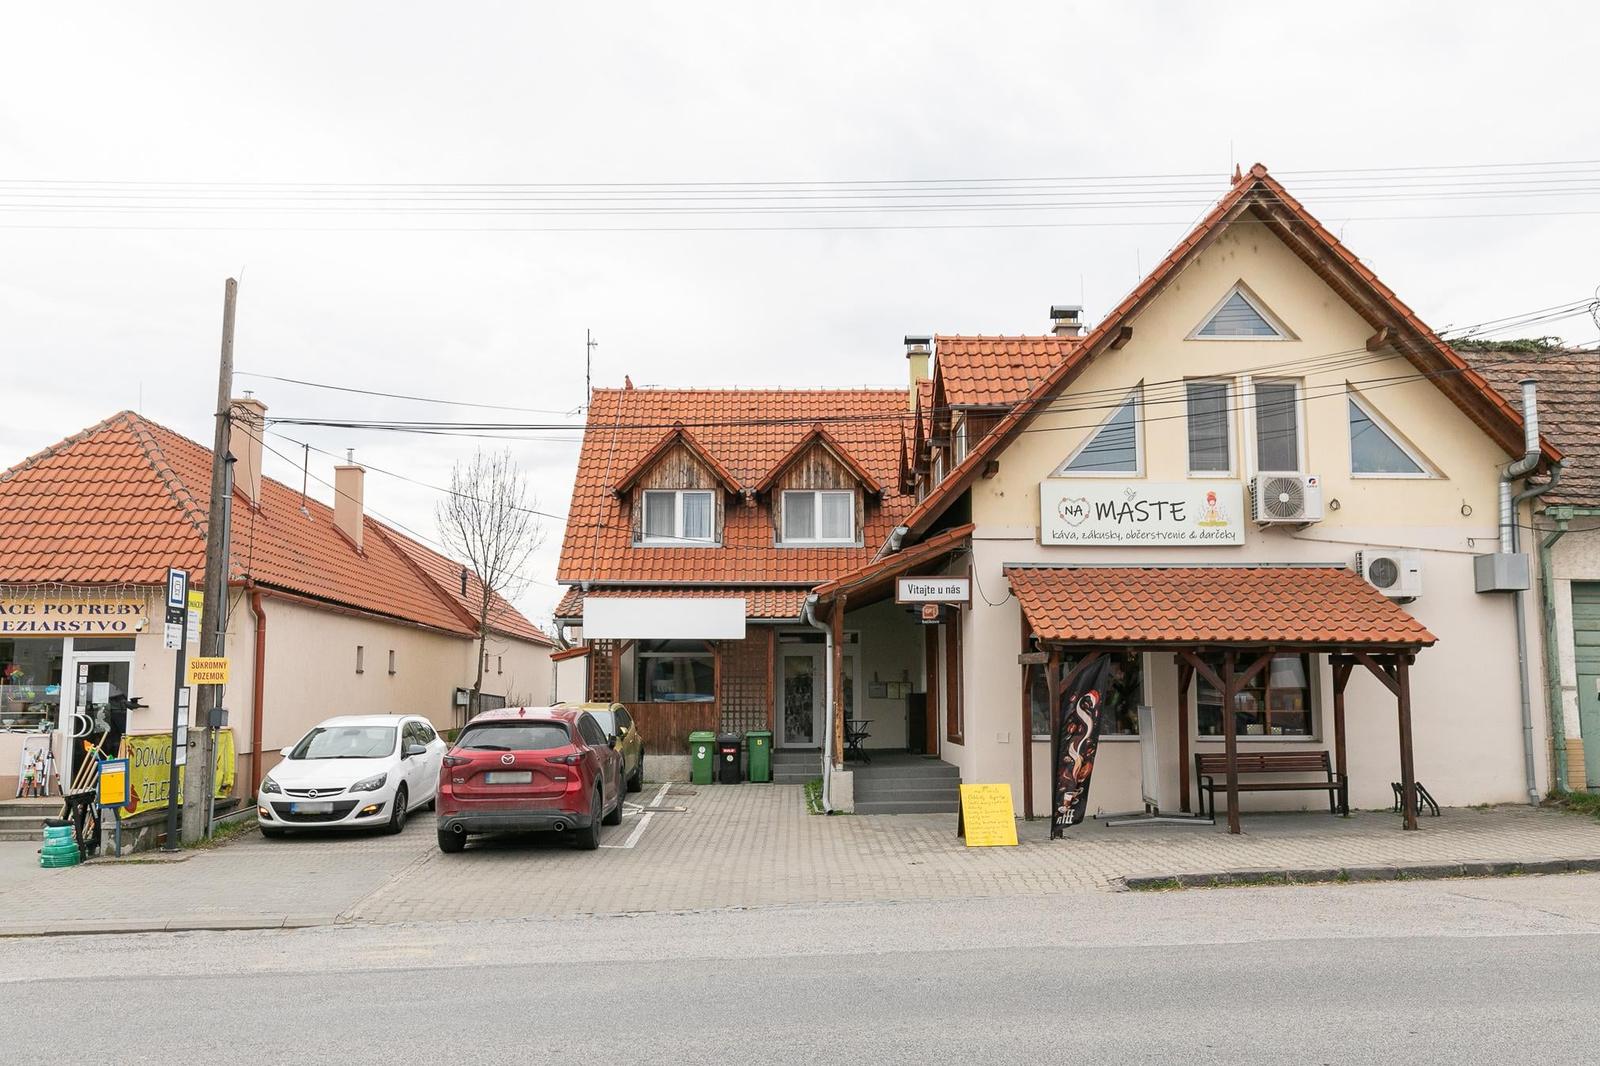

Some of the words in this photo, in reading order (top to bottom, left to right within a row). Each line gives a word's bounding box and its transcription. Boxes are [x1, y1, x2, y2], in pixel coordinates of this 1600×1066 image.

[1065, 504, 1083, 517] NA
[1095, 500, 1186, 524] MASTE
[1052, 529, 1079, 540] káva,
[1081, 529, 1123, 541] zákusky,
[1125, 529, 1186, 540] občerstvenie
[1188, 530, 1197, 539] &
[1199, 529, 1236, 541] darčeky
[907, 583, 935, 596] Vitajte
[945, 584, 961, 594] nás
[43, 604, 145, 615] POTREBY
[2, 620, 127, 632] EZIARSTVO
[193, 672, 225, 680] POZEMOK
[135, 743, 172, 768] DOMÁC
